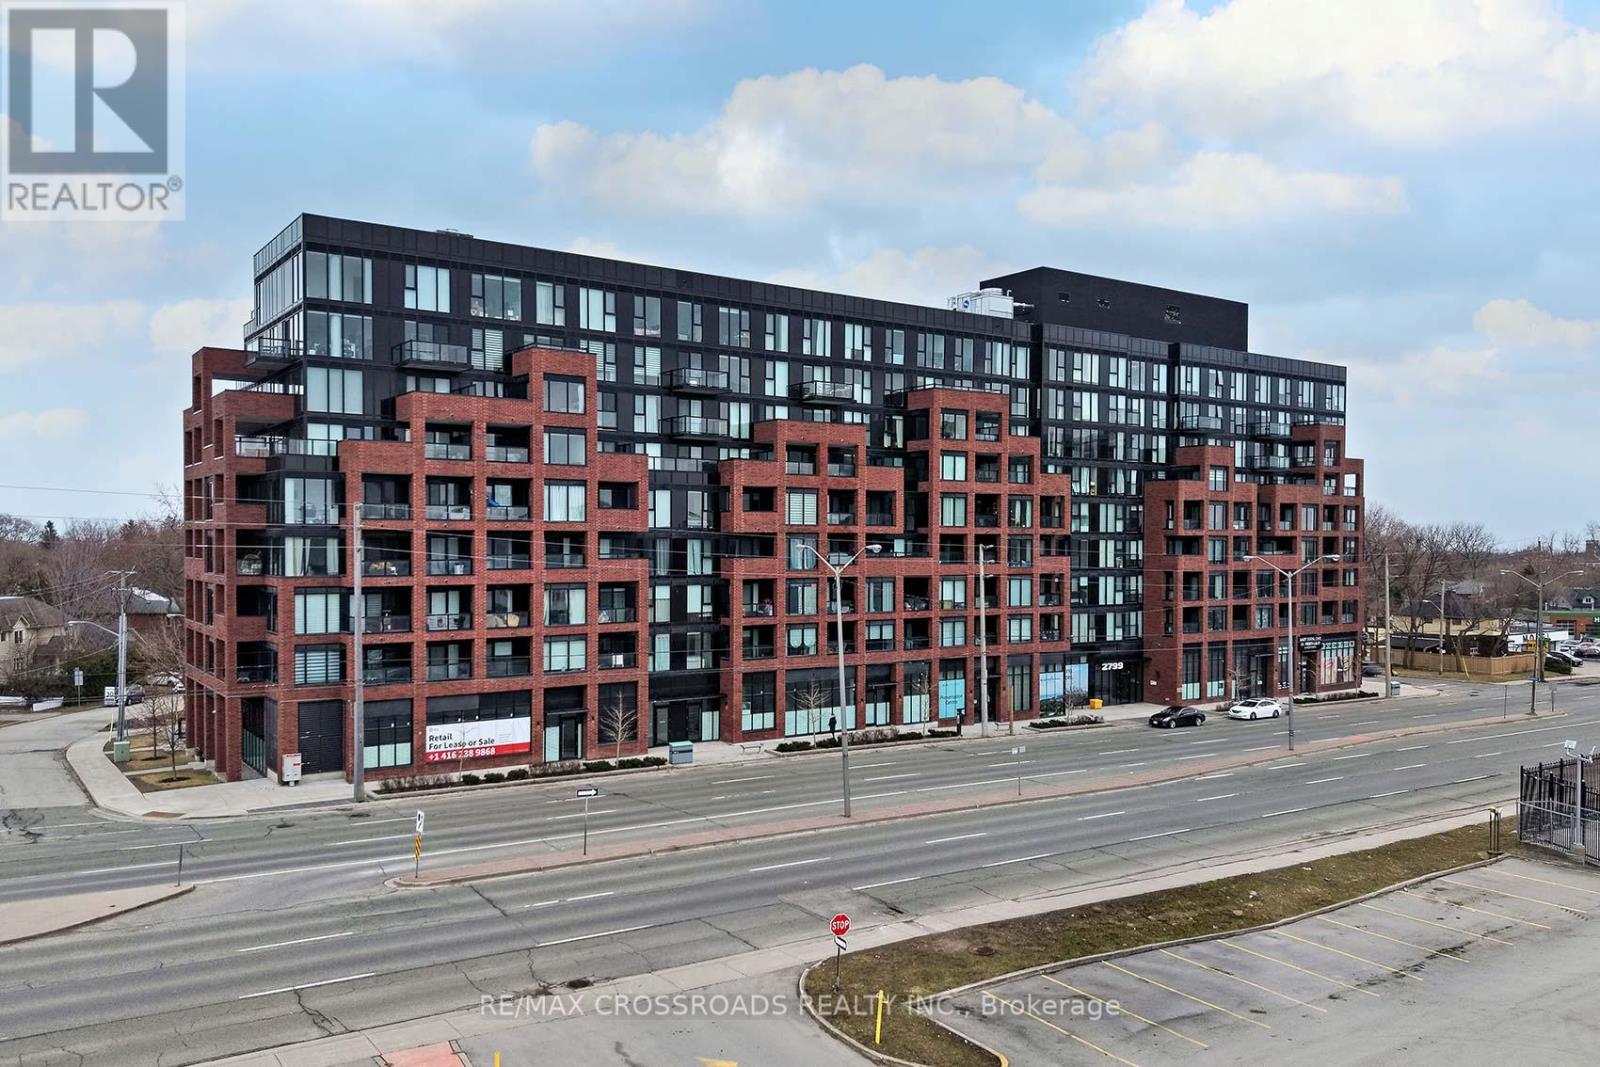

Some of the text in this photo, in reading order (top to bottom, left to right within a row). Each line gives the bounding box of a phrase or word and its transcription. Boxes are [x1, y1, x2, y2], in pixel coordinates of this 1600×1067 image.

[1101, 661, 1123, 670] 2799
[429, 733, 452, 741] Retail
[444, 741, 466, 749] Lease
[478, 738, 494, 746] Sale
[441, 750, 456, 760] 416
[475, 747, 495, 756] 9868
[832, 920, 849, 930] STOP
